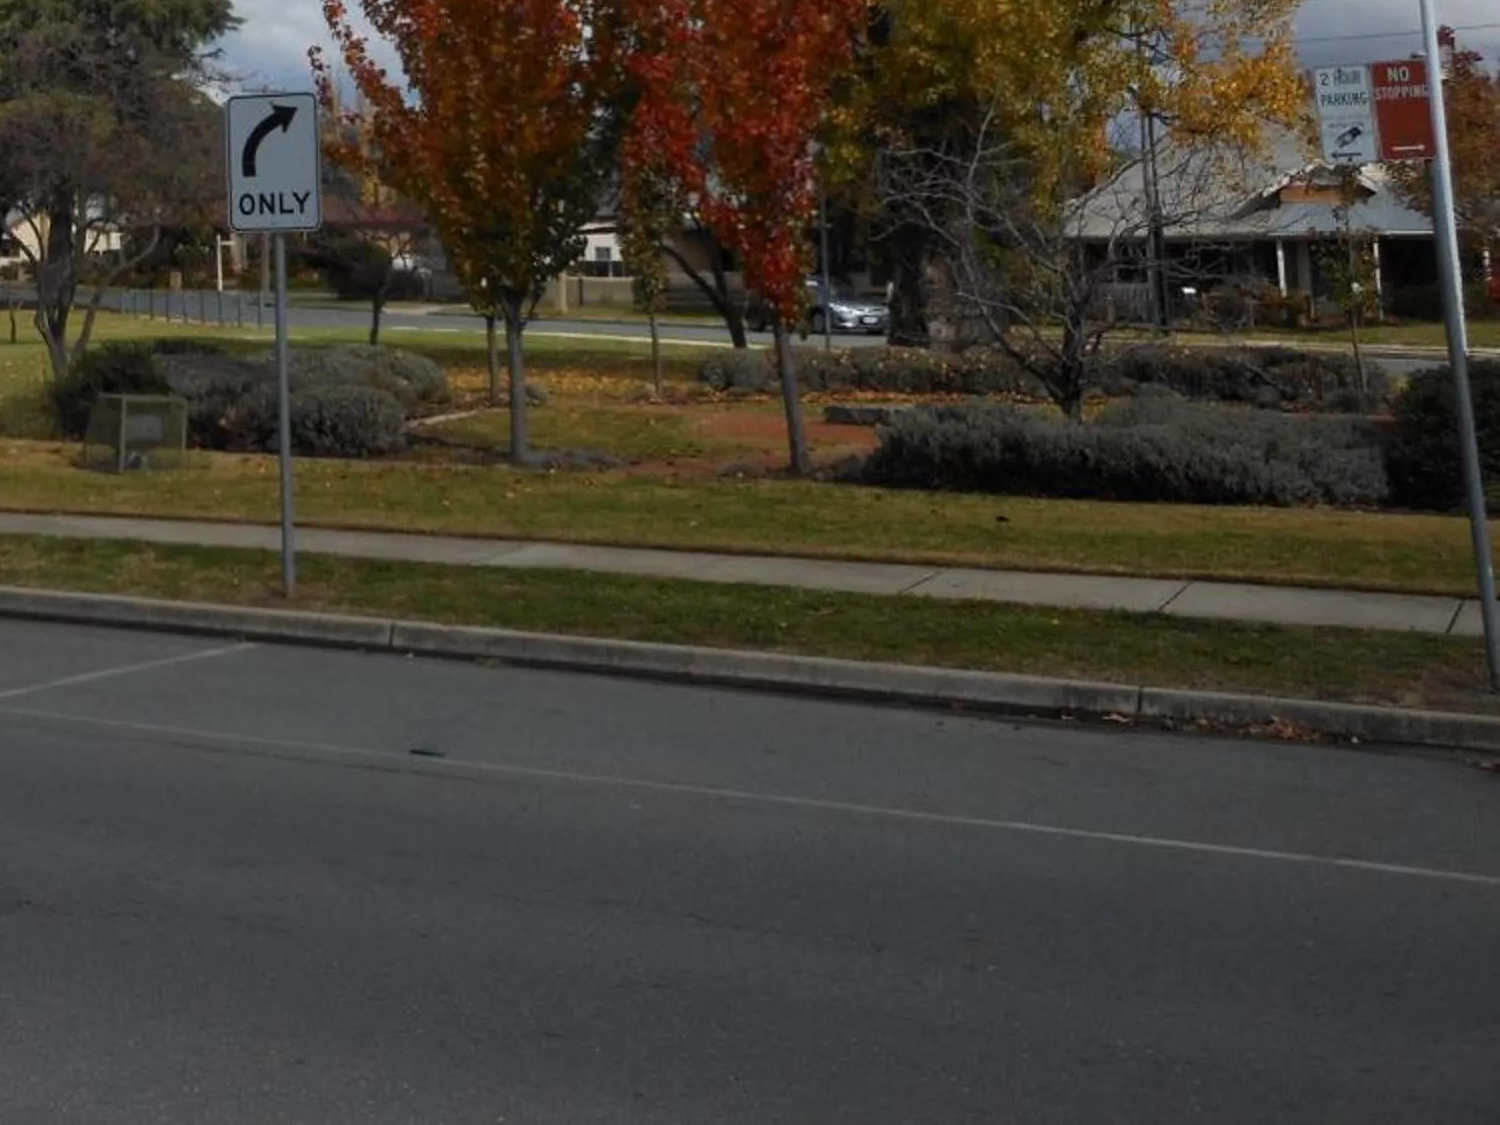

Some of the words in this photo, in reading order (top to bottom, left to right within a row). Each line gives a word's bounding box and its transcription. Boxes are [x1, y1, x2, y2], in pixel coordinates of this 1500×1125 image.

[1320, 73, 1329, 86] 2
[1387, 66, 1409, 82] NO
[1321, 91, 1368, 106] PARKING
[239, 190, 311, 216] ONLY
